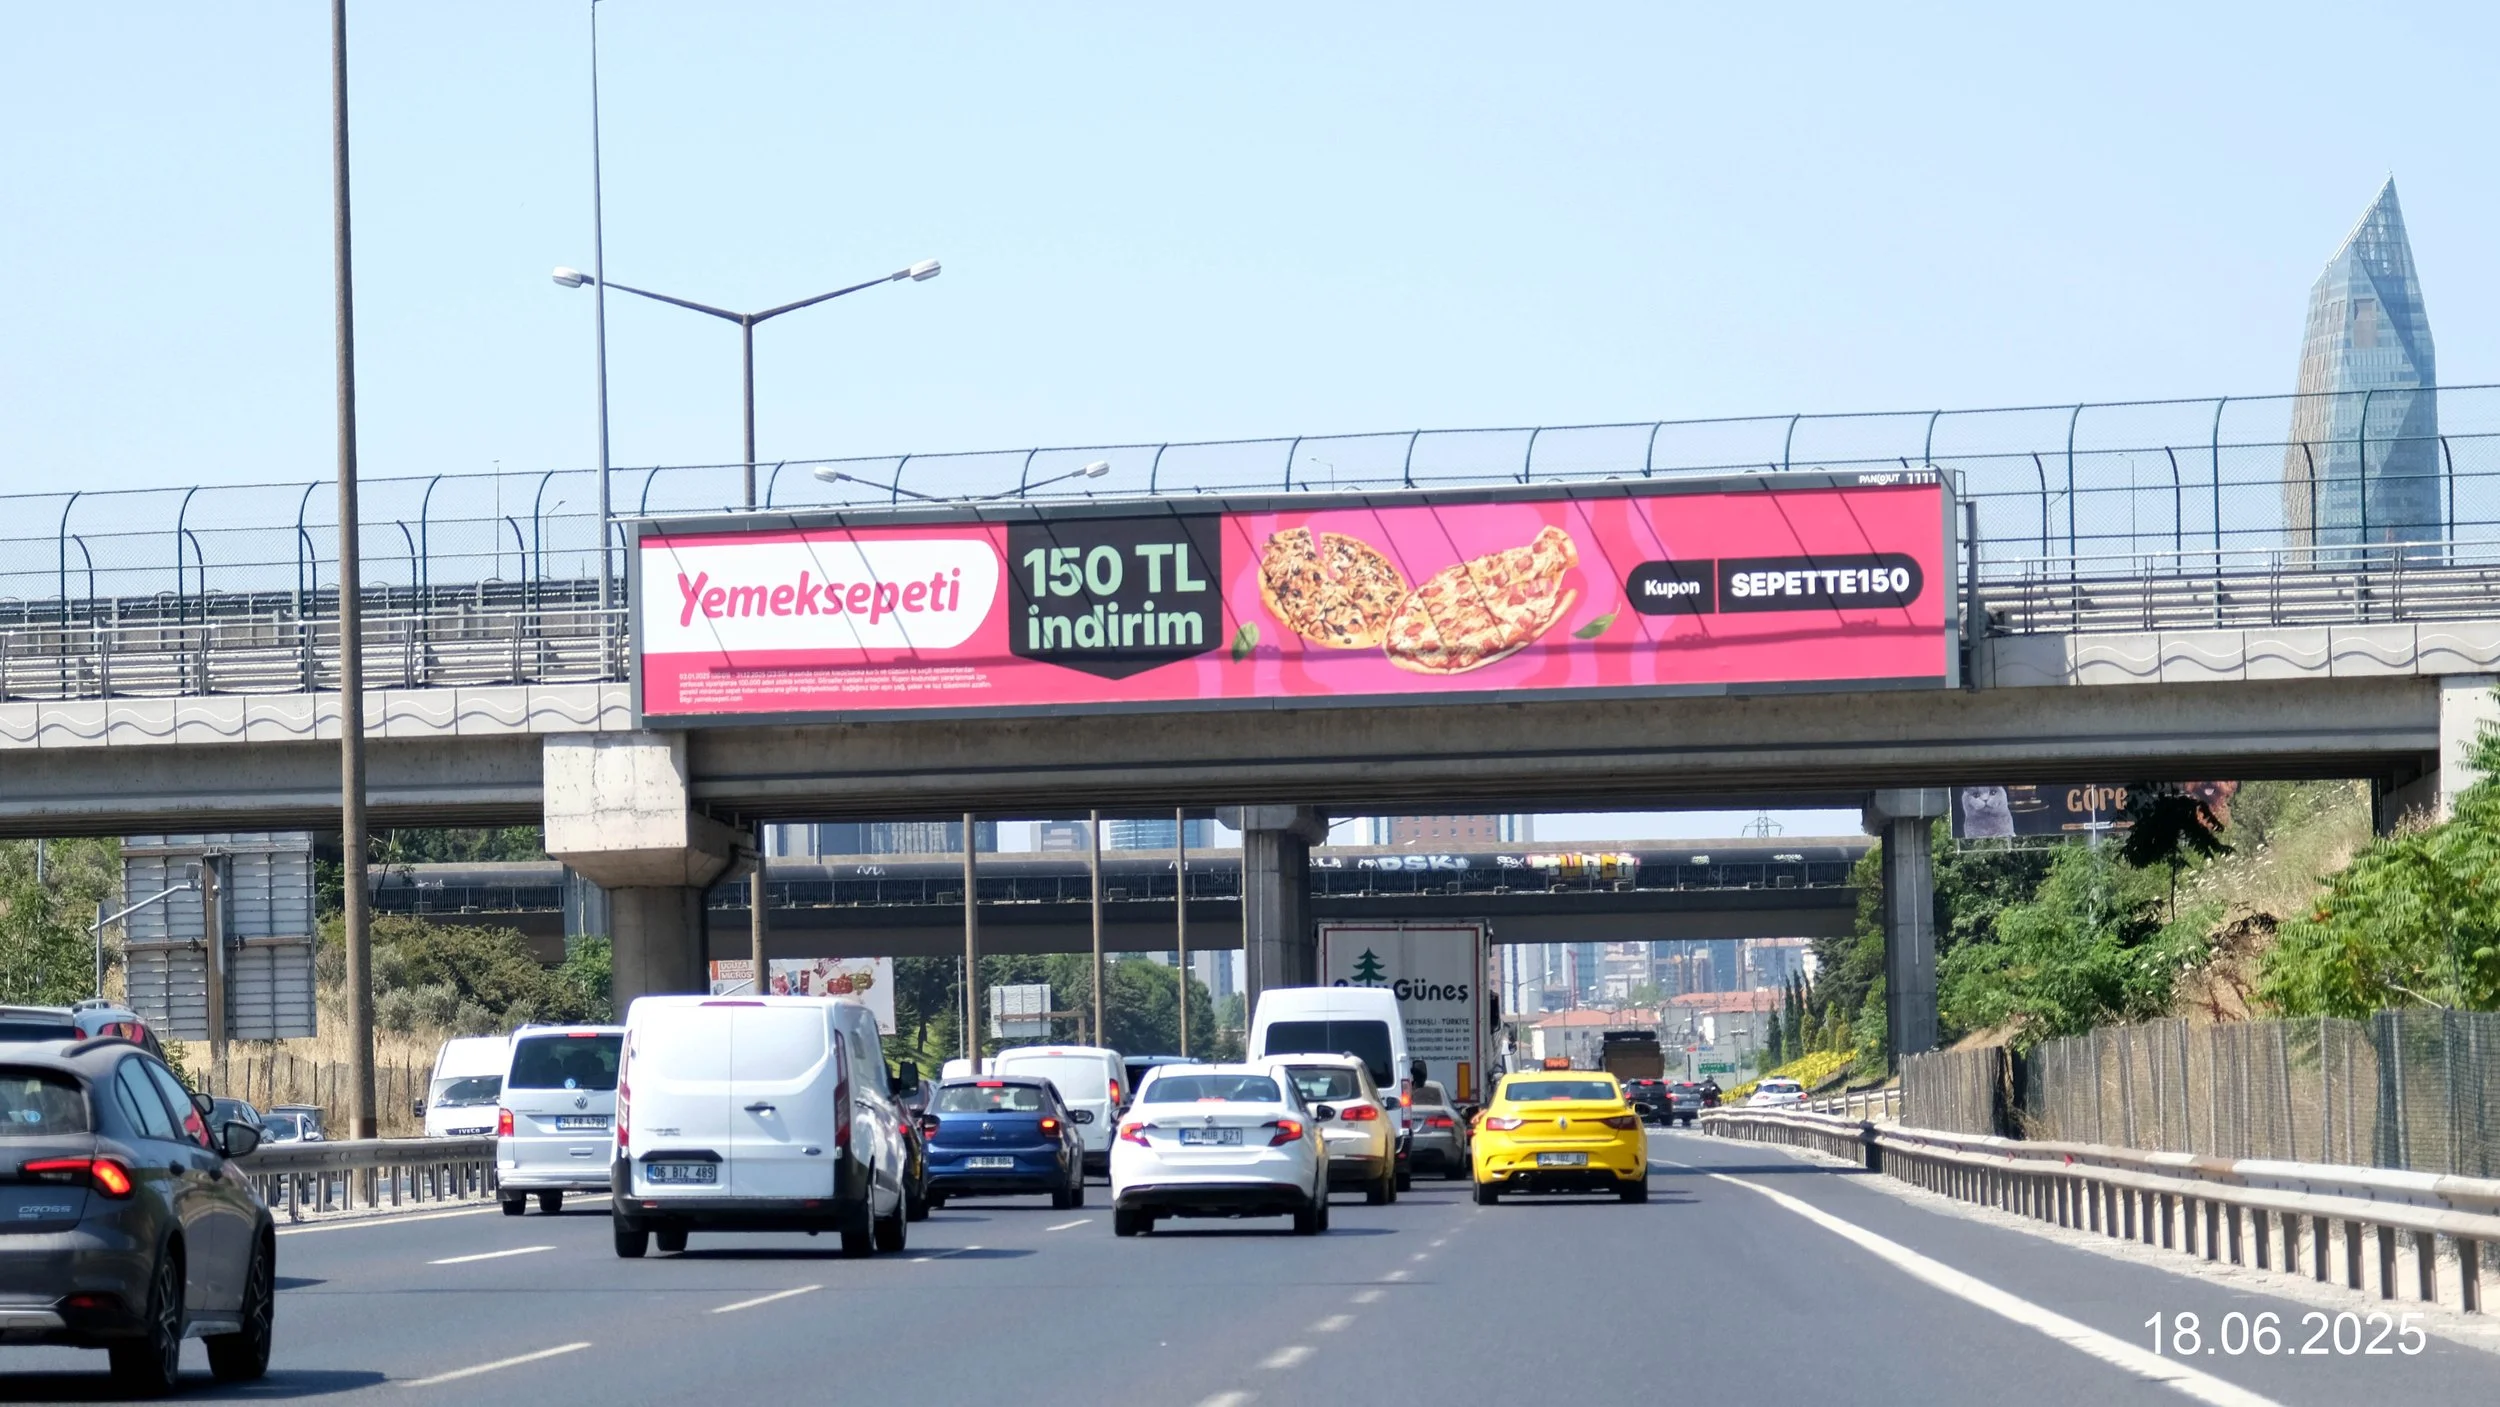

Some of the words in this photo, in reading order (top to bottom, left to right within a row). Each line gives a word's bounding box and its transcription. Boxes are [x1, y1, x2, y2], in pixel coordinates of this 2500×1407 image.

[1023, 545, 1123, 597] 150
[1135, 543, 1206, 593] TL
[1731, 567, 1910, 597] SEPETTE150
[677, 567, 961, 628] Yemeksepeti
[1645, 580, 1700, 598] Kupon
[1028, 600, 1203, 650] indirim
[1393, 978, 1468, 1003] Güneş
[654, 1166, 666, 1178] 06
[672, 1166, 689, 1178] BIZ
[696, 1167, 714, 1178] 489
[19, 1205, 72, 1213] CROSS
